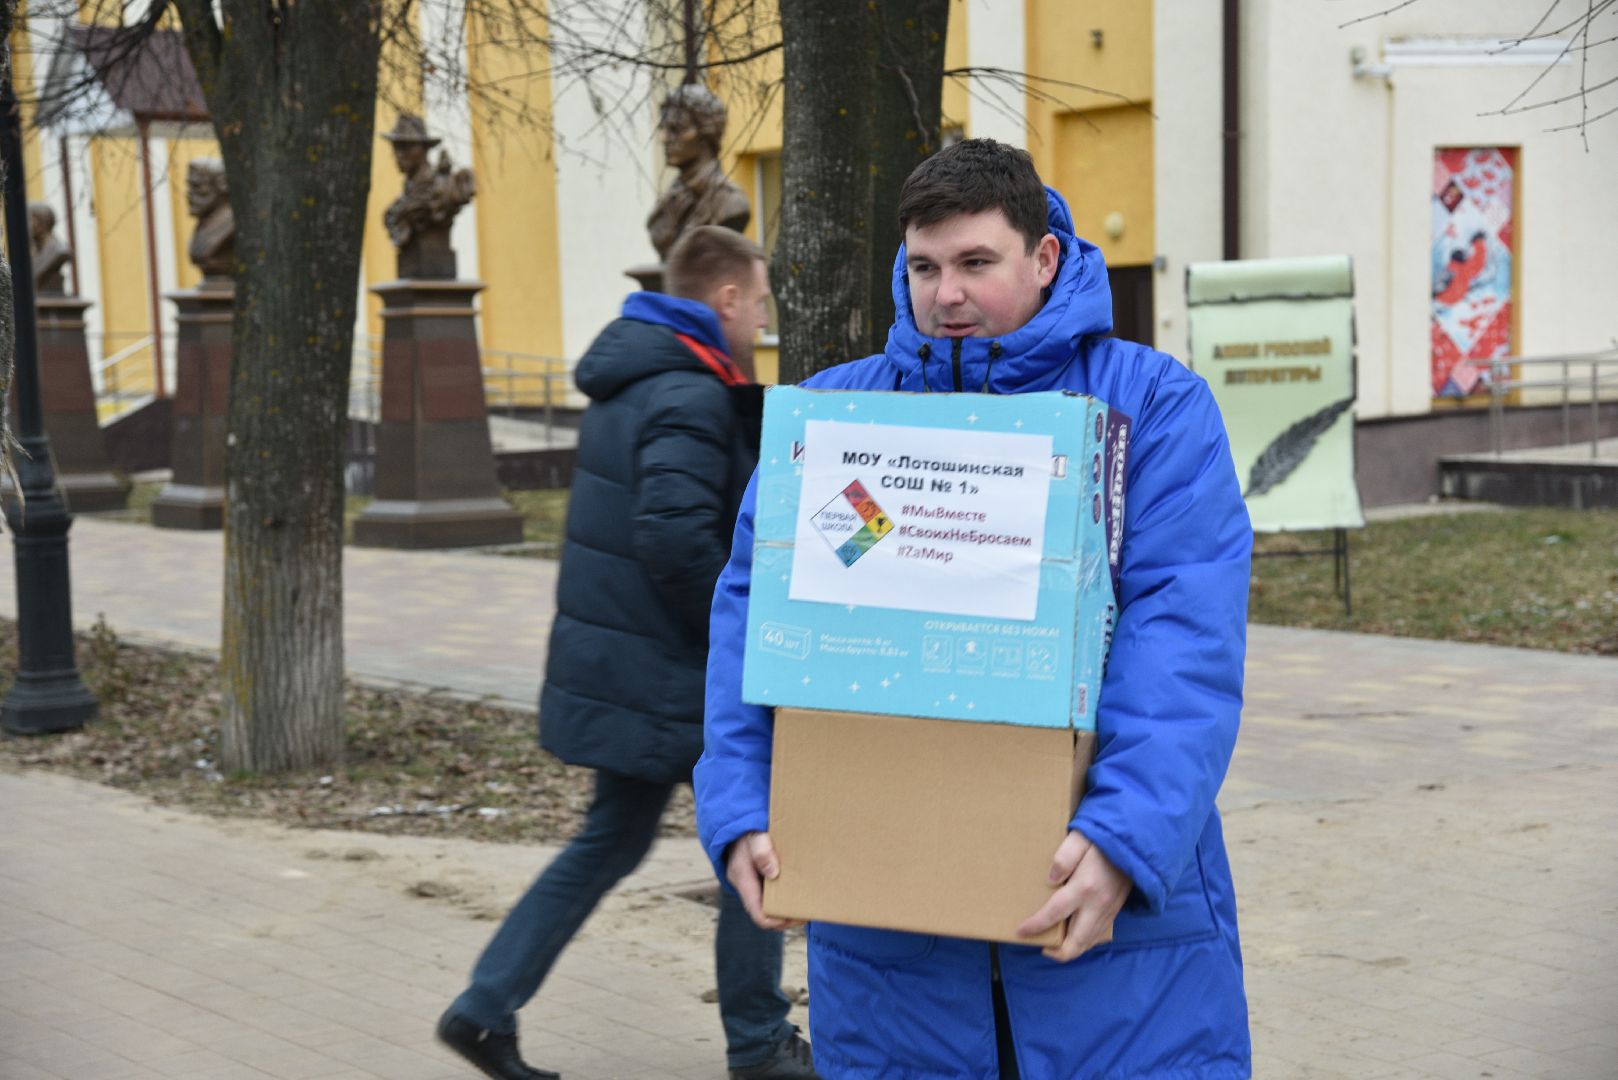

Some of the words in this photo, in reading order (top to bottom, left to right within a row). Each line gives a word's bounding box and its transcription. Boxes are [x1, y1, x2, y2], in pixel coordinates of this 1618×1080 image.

[842, 451, 881, 466] МОУ
[888, 455, 1024, 477] «Лотошинская
[881, 475, 924, 490] СОШ
[930, 479, 952, 492] №
[959, 480, 979, 495] 1»
[821, 511, 857, 522] ПЕРВАЯ
[902, 504, 986, 522] #МыВместе
[822, 522, 852, 532] ШКОЛА
[899, 525, 1032, 546] #СвоихНеБросаем
[764, 629, 784, 645] 40
